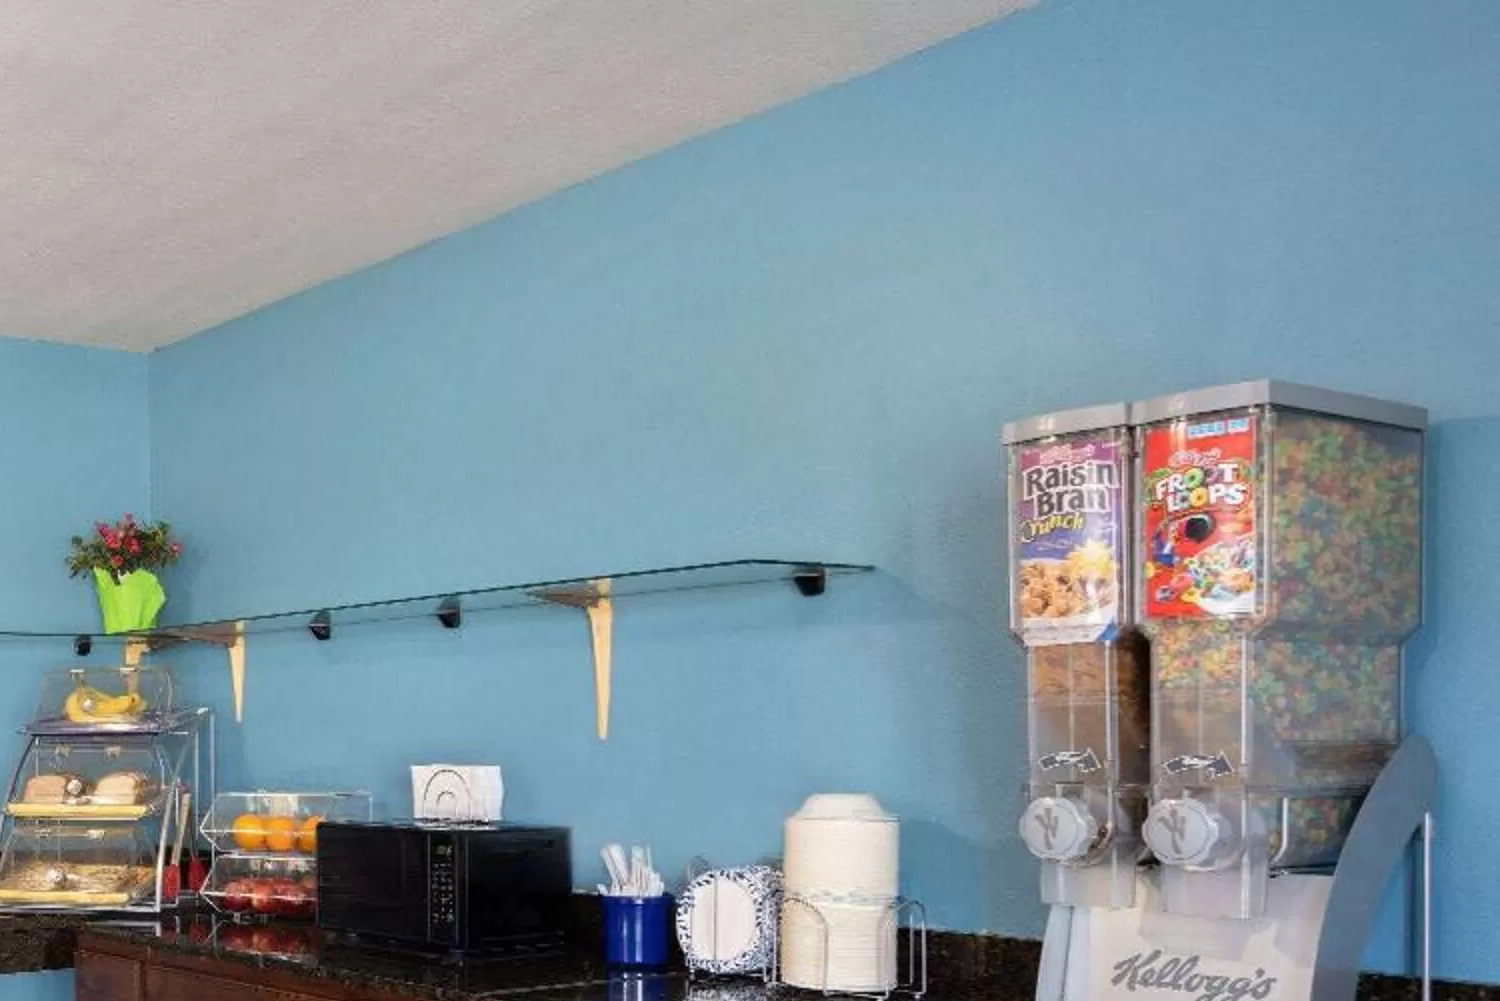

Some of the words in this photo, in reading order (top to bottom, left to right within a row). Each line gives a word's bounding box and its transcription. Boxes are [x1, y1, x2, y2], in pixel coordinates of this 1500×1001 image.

[1024, 461, 1117, 499] Raisin
[1156, 463, 1239, 501] FROOT
[1035, 487, 1109, 518] Bran
[1167, 483, 1248, 512] LOOPS
